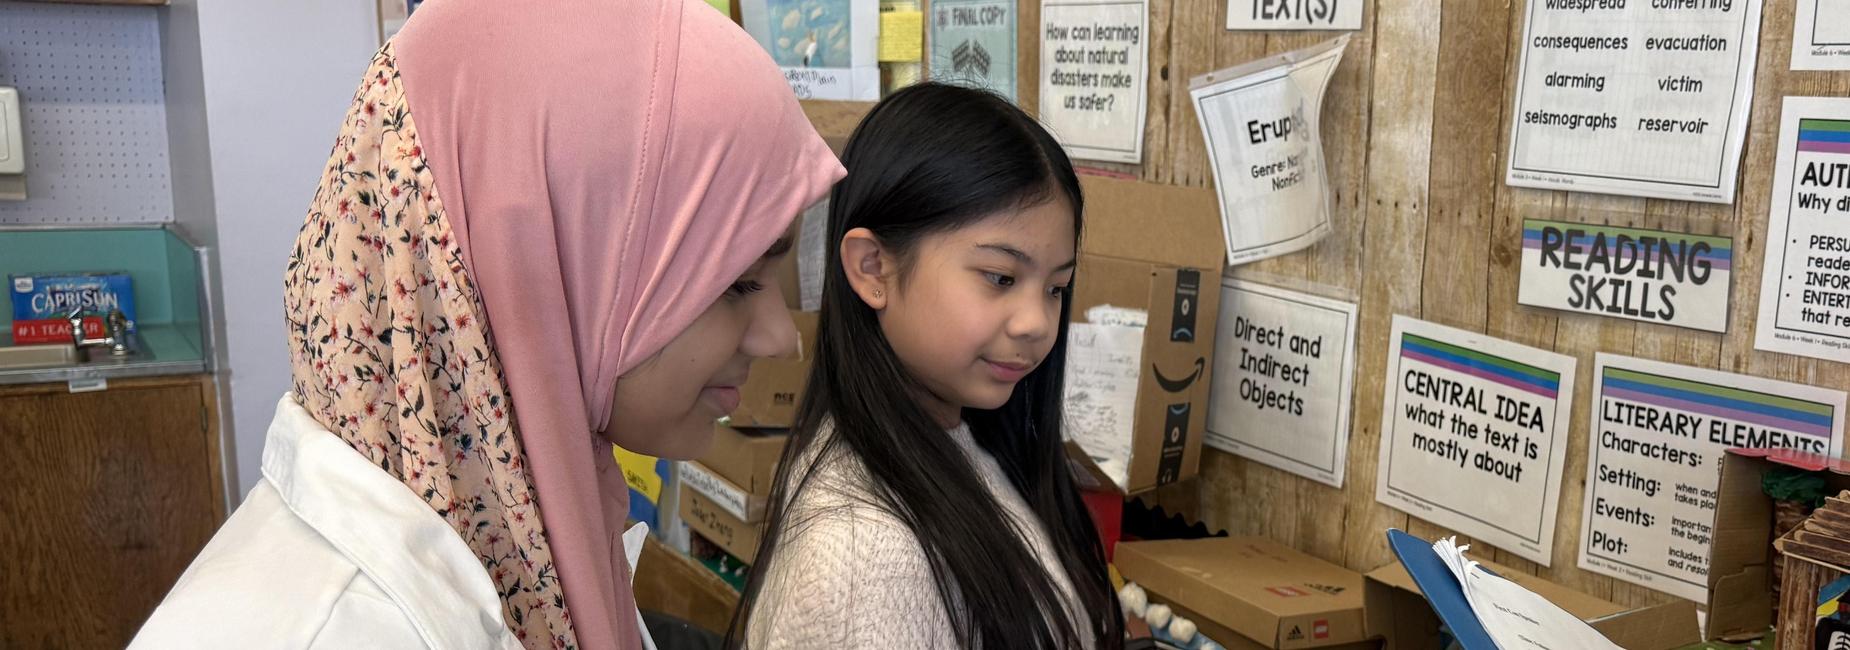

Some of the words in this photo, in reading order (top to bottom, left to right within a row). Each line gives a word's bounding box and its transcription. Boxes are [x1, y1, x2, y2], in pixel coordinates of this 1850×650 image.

[952, 7, 978, 26] FINAL
[980, 5, 1007, 26] COPY
[1046, 22, 1069, 40] How
[1071, 26, 1091, 40] can
[1094, 23, 1139, 44] learning
[1534, 35, 1628, 52] consequences
[1645, 35, 1727, 51] evacuation
[1055, 46, 1085, 64] about
[1088, 46, 1129, 65] natural
[1050, 69, 1099, 87] disasters
[1101, 70, 1132, 88] make
[1545, 72, 1605, 92] alarming
[1658, 76, 1703, 93] victim
[1064, 95, 1076, 109] us
[1078, 93, 1115, 112] safer?
[1247, 114, 1299, 145] Erup
[1524, 109, 1617, 131] seismographs
[1638, 117, 1709, 134] reservoir
[1251, 160, 1287, 179] Genre:
[1798, 192, 1831, 214] Why
[1539, 225, 1712, 285] READING
[1566, 274, 1677, 321] SKILLS
[1801, 307, 1831, 325] that
[42, 322, 98, 337] TEACER
[1234, 316, 1284, 350] Direct
[1289, 335, 1322, 359] and
[1239, 347, 1309, 387] Indirect
[1240, 377, 1304, 416] Objects
[1404, 369, 1487, 415] CENTRAL
[1494, 394, 1544, 433] IDEA
[1603, 400, 1702, 439] LITERARY
[1405, 403, 1445, 430] what
[1450, 413, 1479, 439] the
[1484, 423, 1519, 454] text
[1524, 437, 1538, 460] is
[1412, 432, 1469, 468] mostly
[1474, 451, 1523, 483] about
[1602, 430, 1702, 467] Characters:
[1599, 464, 1661, 497] Setting:
[1675, 482, 1698, 496] when
[1700, 488, 1717, 499] and
[1595, 497, 1655, 527] Events:
[1674, 493, 1698, 506] takes
[1700, 499, 1716, 510] pla
[1671, 516, 1711, 533] importan
[1671, 527, 1685, 538] the
[1592, 530, 1628, 555] Plot:
[1667, 558, 1684, 570] and
[1668, 546, 1702, 563] includes
